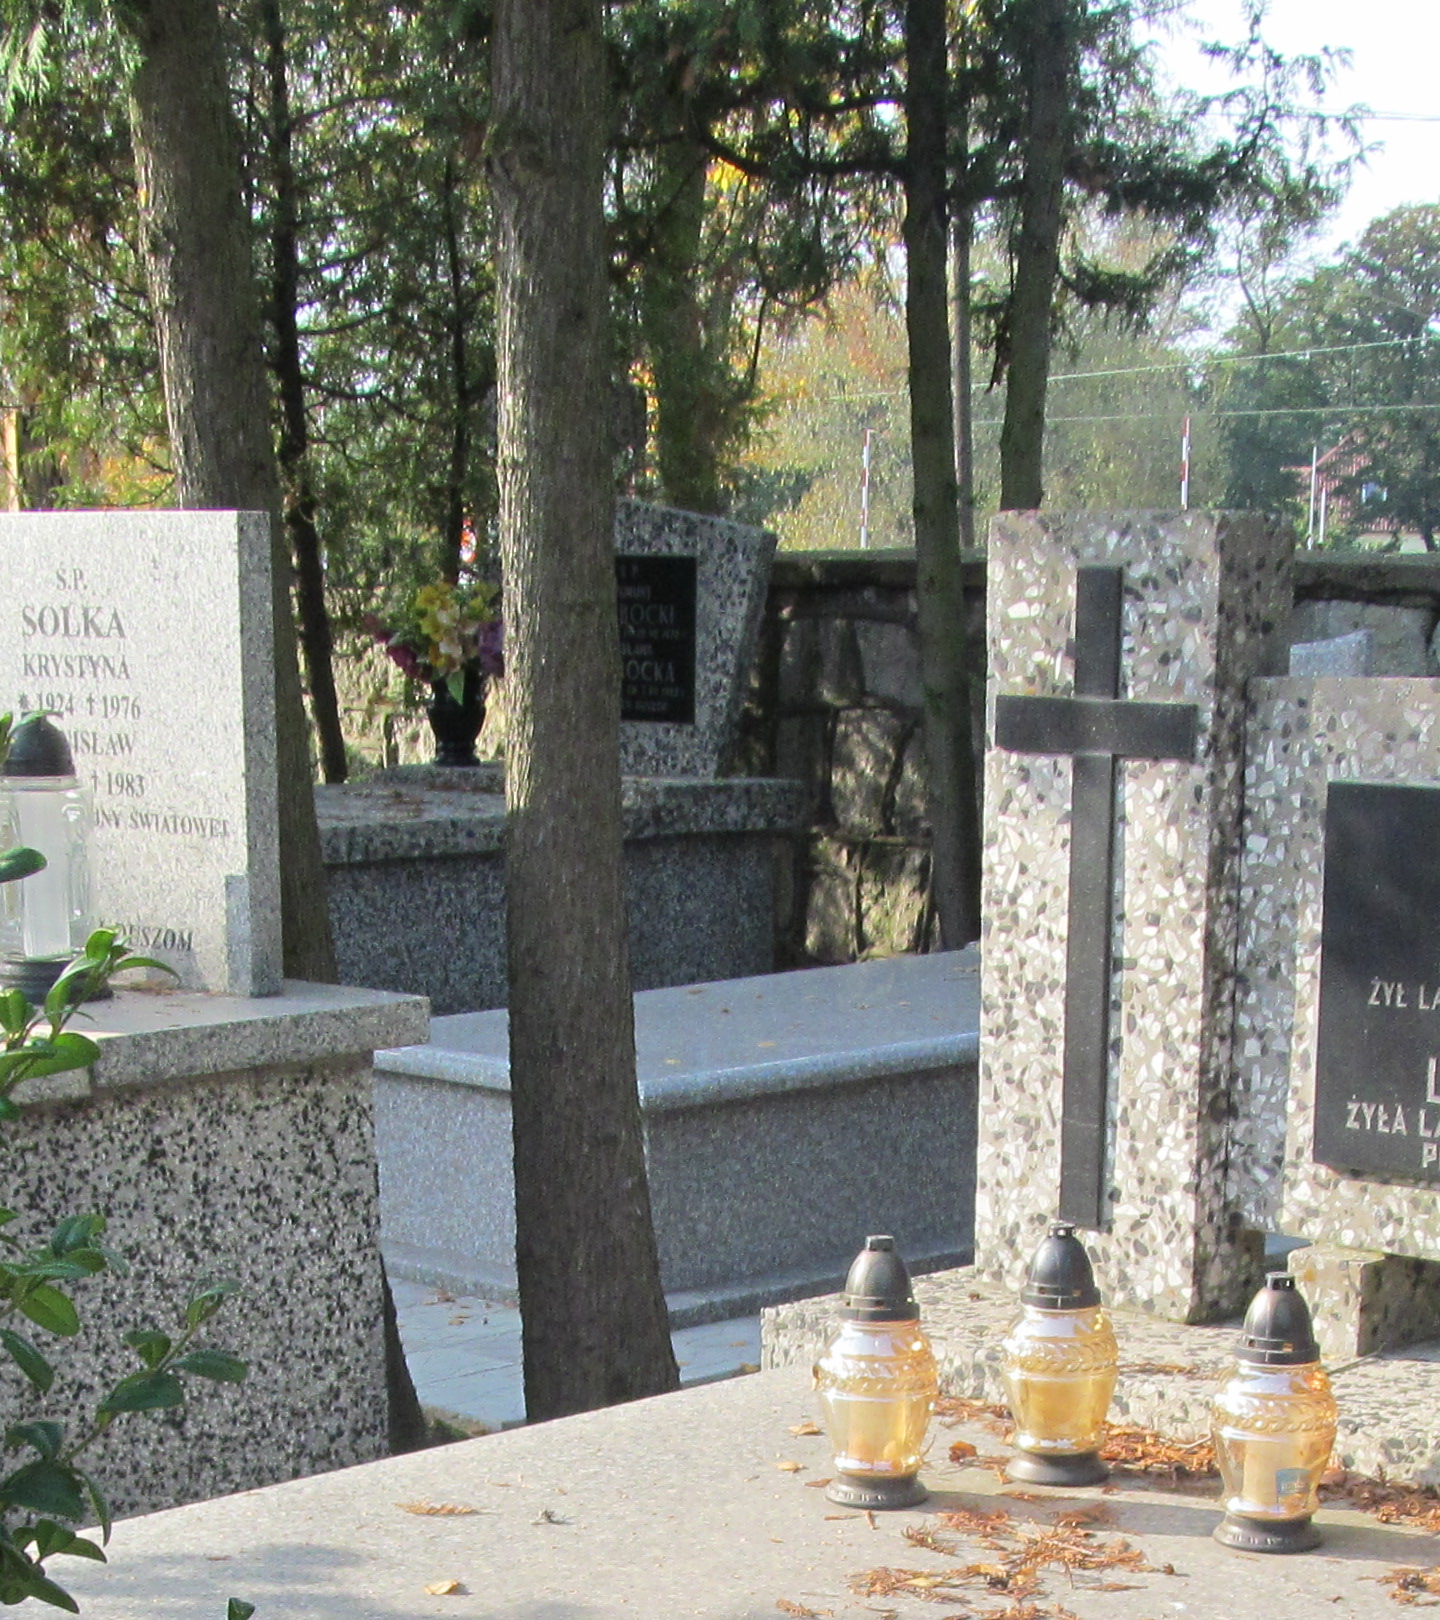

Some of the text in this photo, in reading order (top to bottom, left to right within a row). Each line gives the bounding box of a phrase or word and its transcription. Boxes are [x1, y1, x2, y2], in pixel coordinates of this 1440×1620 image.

[21, 603, 127, 639] SOLKA
[22, 652, 131, 680] KRYSTYNA
[101, 694, 141, 720] 1976
[107, 771, 145, 798] 1983
[1368, 976, 1408, 1008] ŻYŁ
[1345, 1094, 1408, 1136] ŻYŁA
